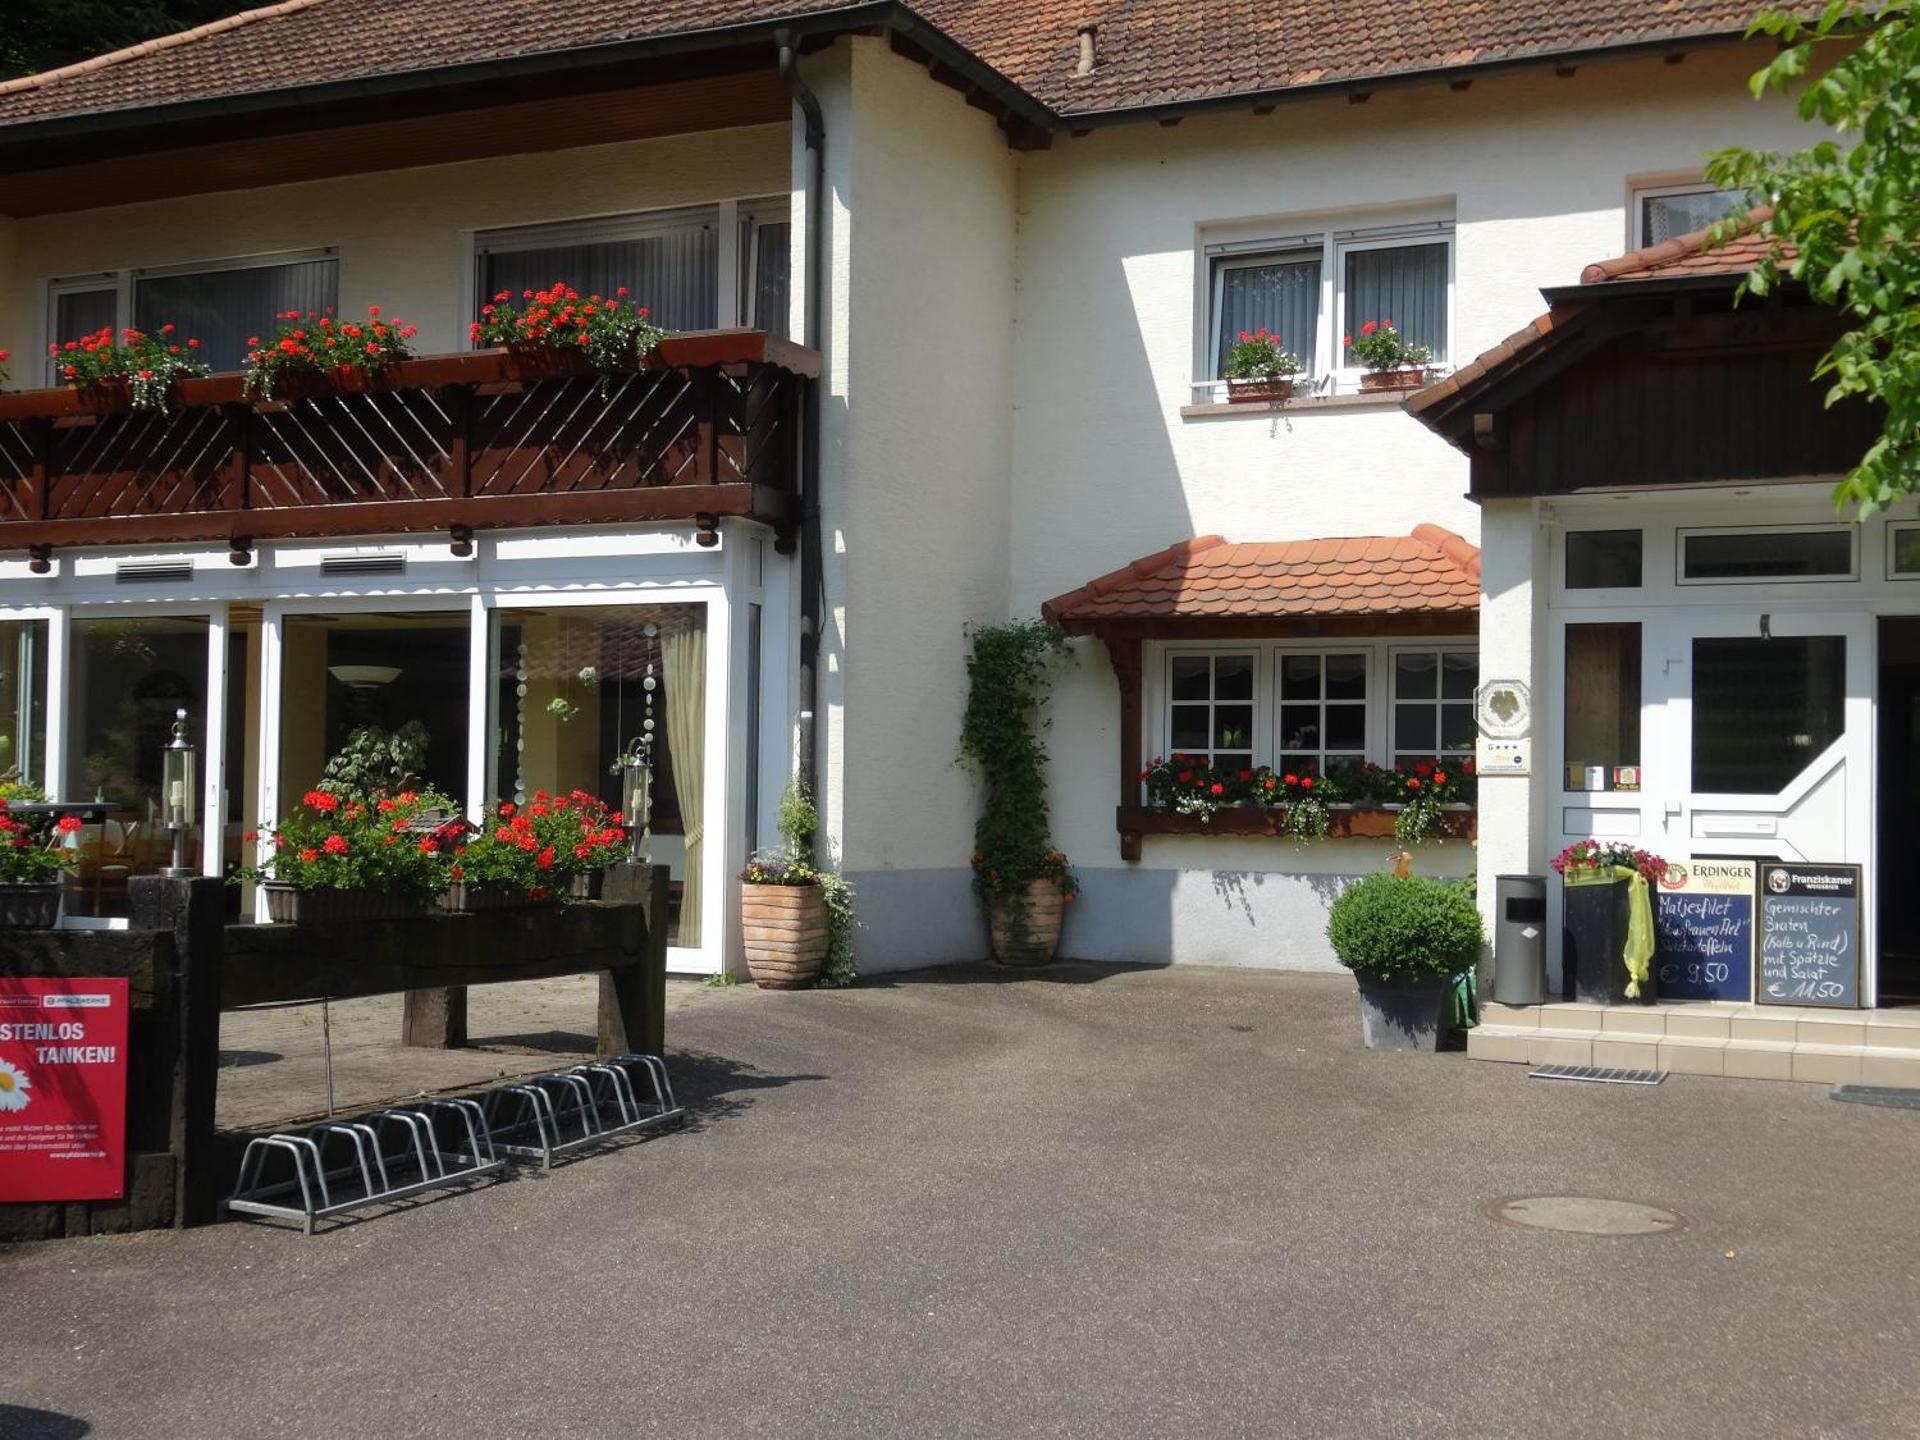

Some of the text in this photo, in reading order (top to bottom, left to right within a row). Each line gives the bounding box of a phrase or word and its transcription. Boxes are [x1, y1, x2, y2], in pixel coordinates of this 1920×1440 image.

[1693, 864, 1752, 878] ERDINGER
[1791, 874, 1853, 885] Franziskaner
[1659, 895, 1733, 919] Matjesfilet
[1764, 898, 1840, 916] Gemischter
[1764, 915, 1808, 932] Braten
[1763, 950, 1840, 967] mit Spätzle
[1687, 962, 1729, 985] 9,50
[1764, 965, 1828, 980] und Salat
[1790, 981, 1844, 1000] 11,50
[36, 1046, 116, 1064] TANKEN!
